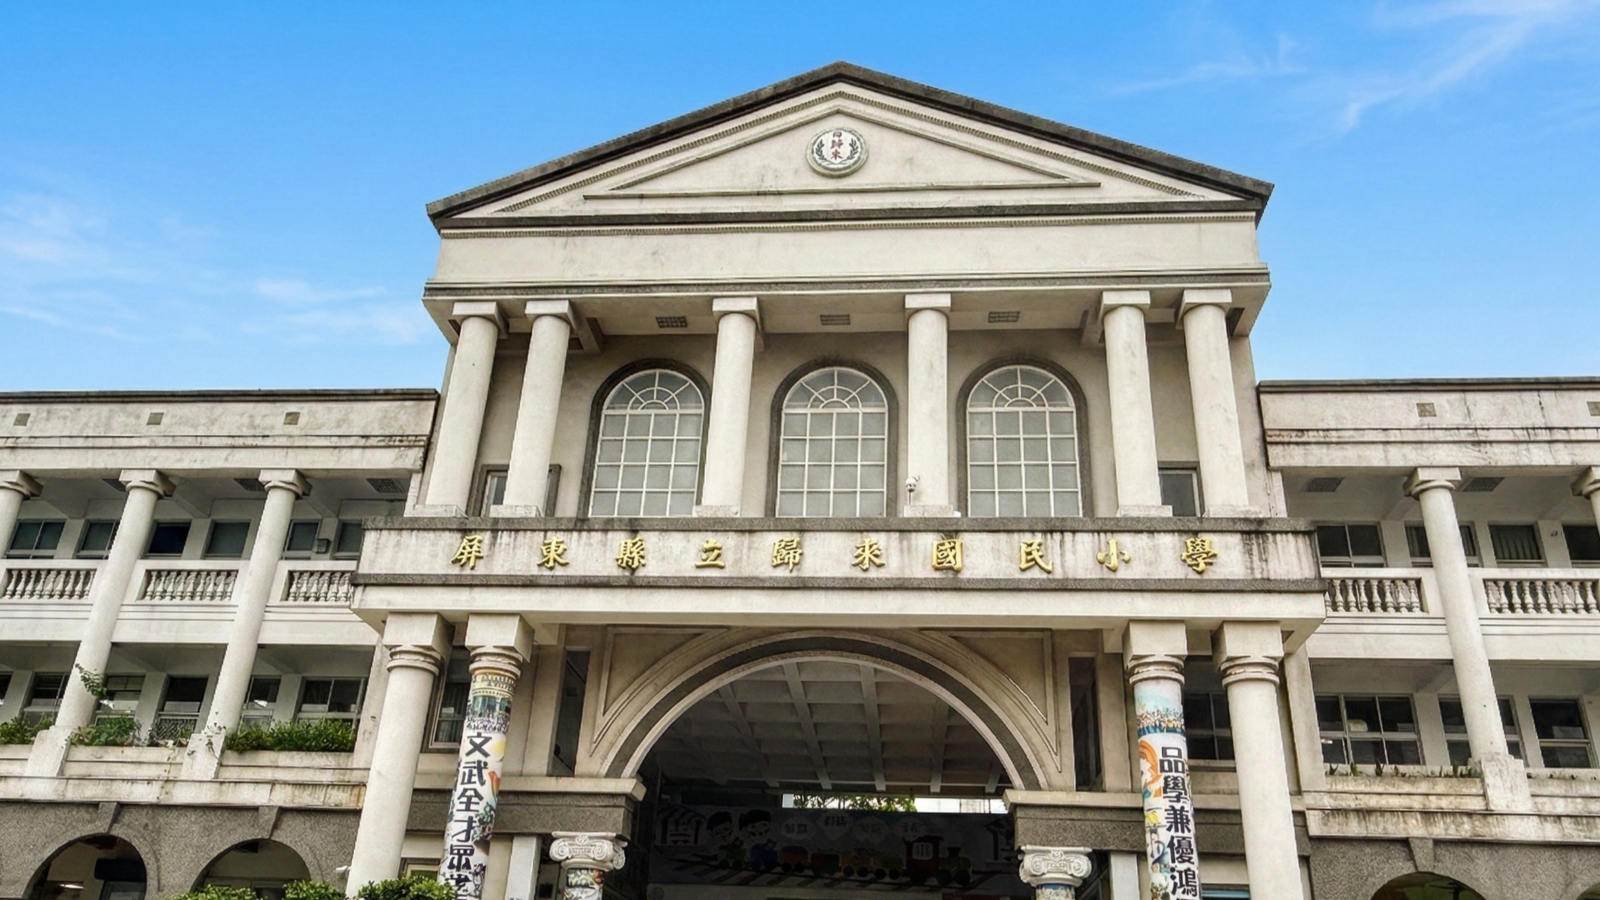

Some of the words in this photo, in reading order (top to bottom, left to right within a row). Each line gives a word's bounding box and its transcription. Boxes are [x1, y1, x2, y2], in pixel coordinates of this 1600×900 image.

[451, 534, 1218, 573] 屏東縣立歸來國民小學
[1159, 747, 1198, 900] 品學兼優鴻
